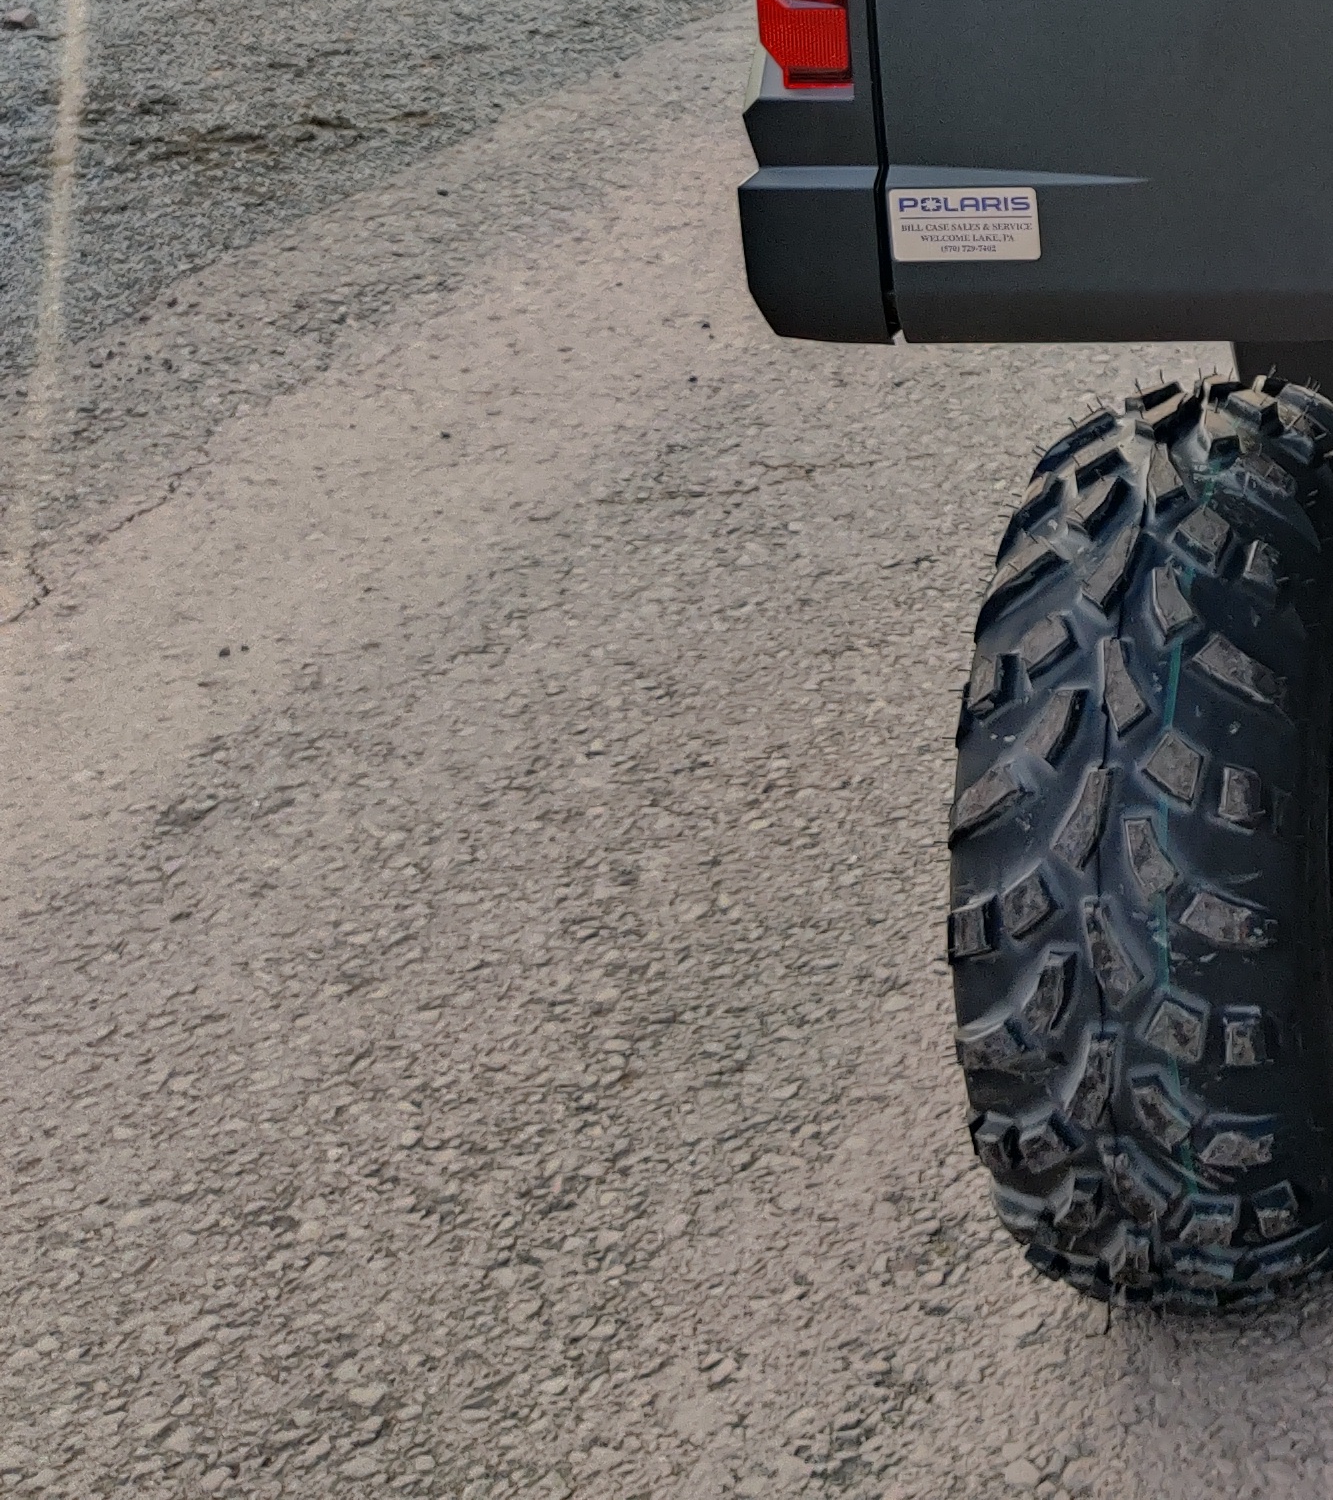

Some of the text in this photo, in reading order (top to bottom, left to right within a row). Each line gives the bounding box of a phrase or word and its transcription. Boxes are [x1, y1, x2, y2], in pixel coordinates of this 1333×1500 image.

[898, 195, 1031, 213] POLARIS
[901, 222, 1033, 232] BILL CASE SALES & SERVICE
[920, 234, 971, 243] WELCOME
[1003, 233, 1015, 242] PA
